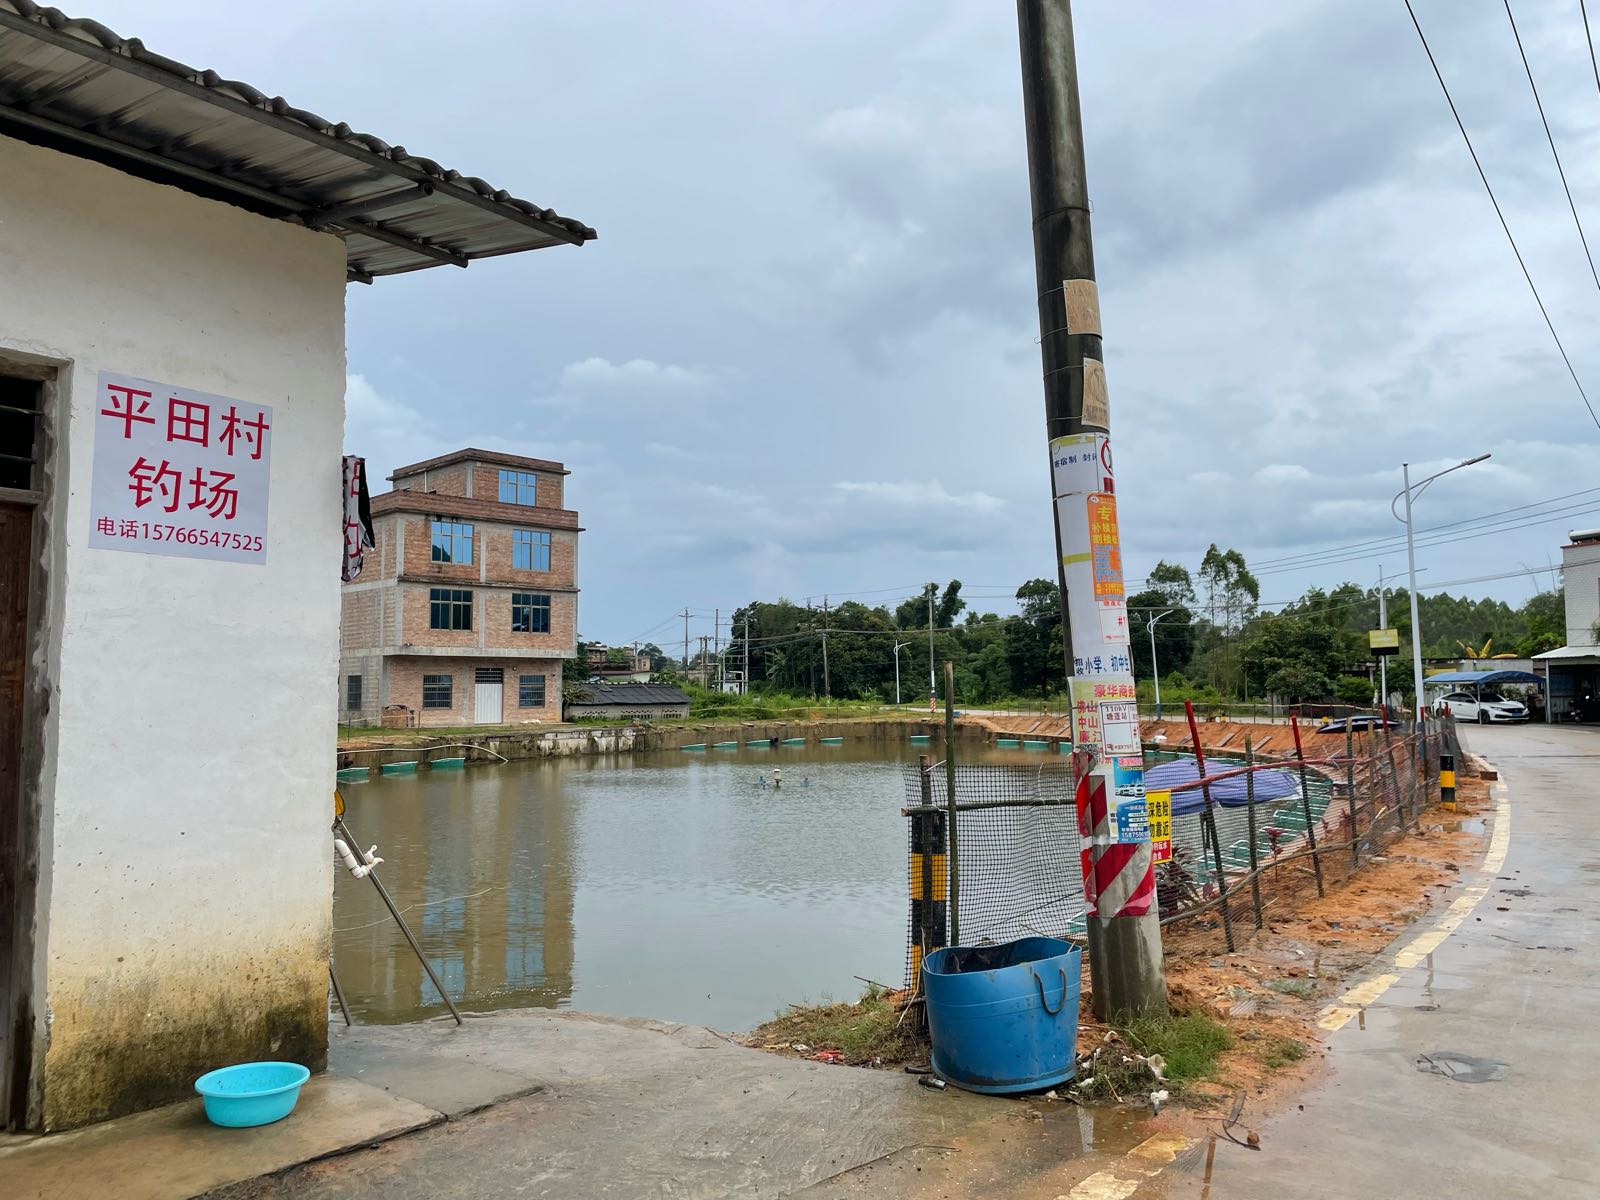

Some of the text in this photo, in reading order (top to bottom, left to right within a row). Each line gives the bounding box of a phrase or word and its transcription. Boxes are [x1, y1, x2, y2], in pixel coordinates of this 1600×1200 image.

[101, 384, 270, 460] 平田村
[128, 456, 238, 520] 钓场
[97, 516, 263, 551] 电话15766547525
